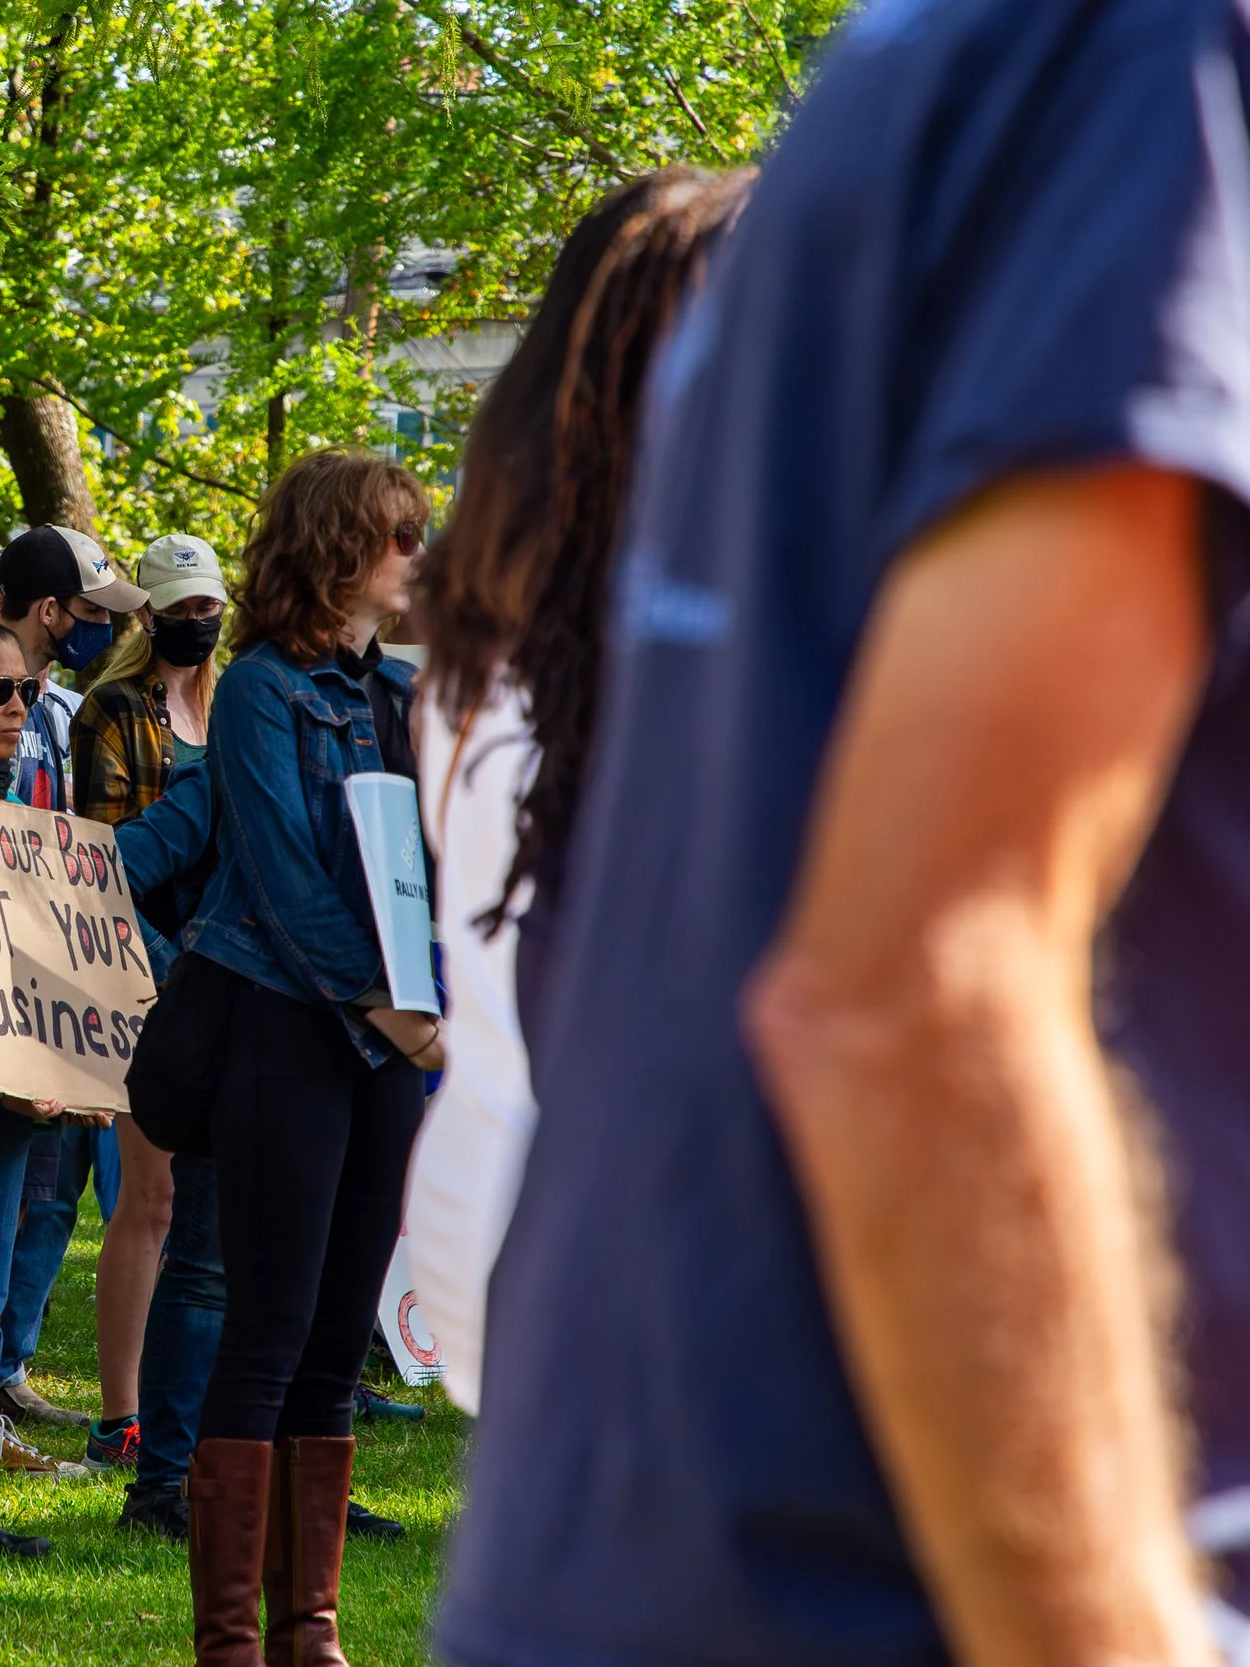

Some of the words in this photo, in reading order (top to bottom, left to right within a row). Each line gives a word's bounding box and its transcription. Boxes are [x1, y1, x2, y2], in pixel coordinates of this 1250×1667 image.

[54, 815, 123, 896] BODY
[394, 878, 418, 899] RALLY
[50, 900, 150, 978] YOUR
